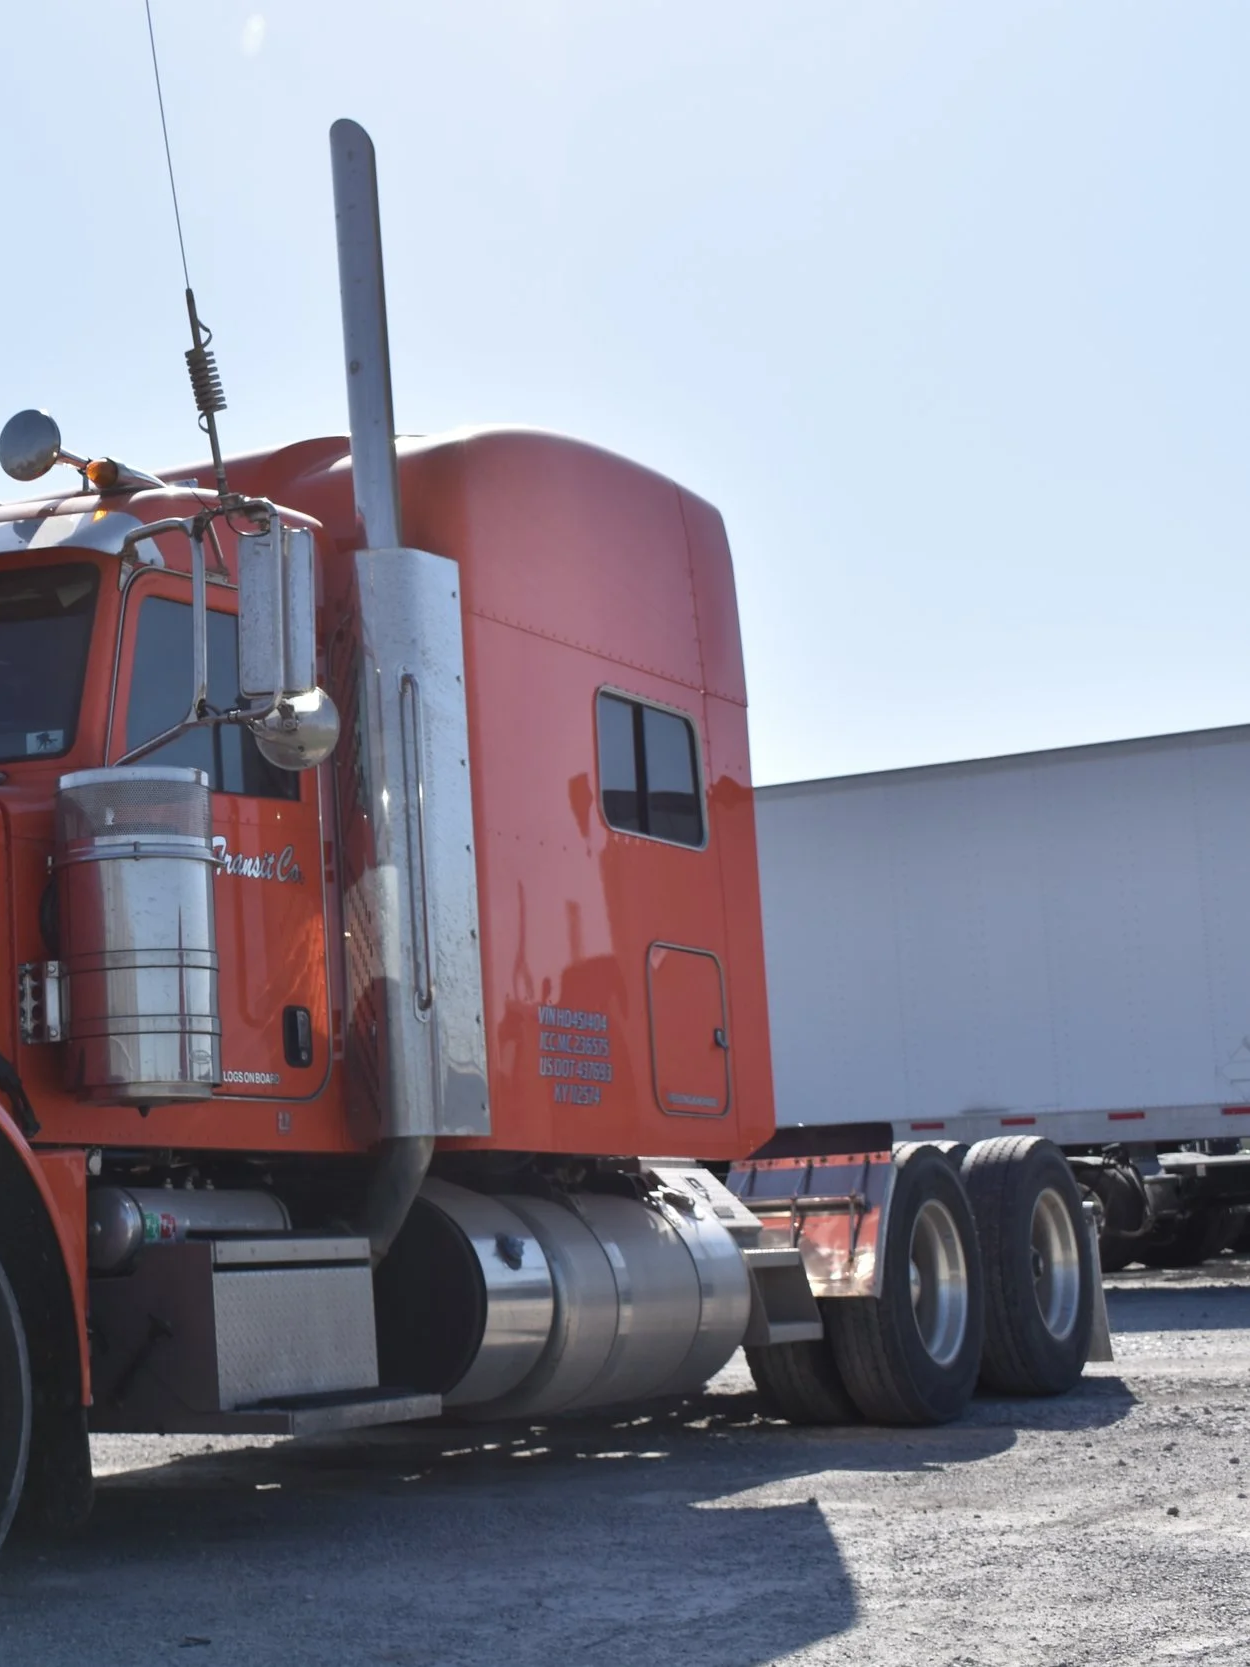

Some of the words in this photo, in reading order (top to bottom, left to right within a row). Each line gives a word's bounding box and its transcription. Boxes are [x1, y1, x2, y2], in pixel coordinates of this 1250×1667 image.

[212, 836, 275, 879] Transit
[538, 1006, 555, 1025] VIN
[223, 1070, 243, 1083] LOGS
[244, 1072, 255, 1083] ON
[540, 1057, 553, 1076] US
[554, 1058, 575, 1077] DOT
